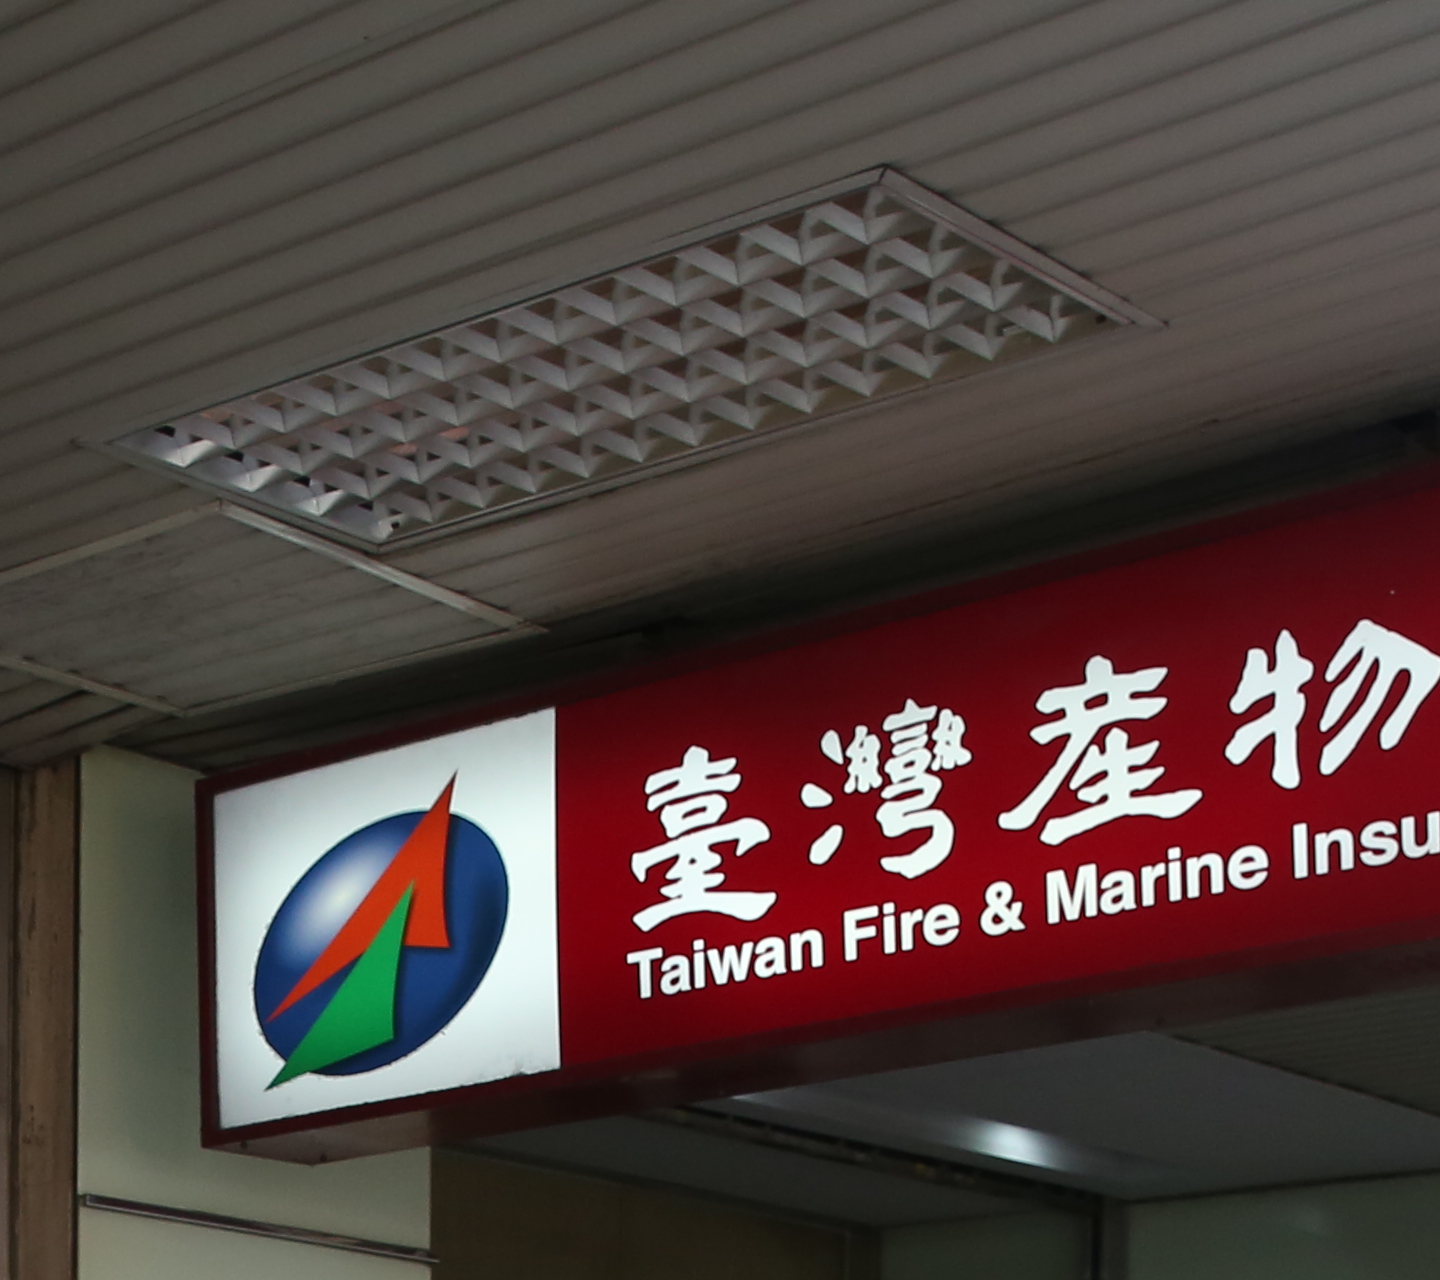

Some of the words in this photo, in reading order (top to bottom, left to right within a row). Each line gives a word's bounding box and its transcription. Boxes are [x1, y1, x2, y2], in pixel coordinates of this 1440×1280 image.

[626, 929, 824, 1000] Taiwan
[843, 901, 961, 963] Fire
[980, 880, 1026, 936] &
[1046, 845, 1269, 926] Marine
